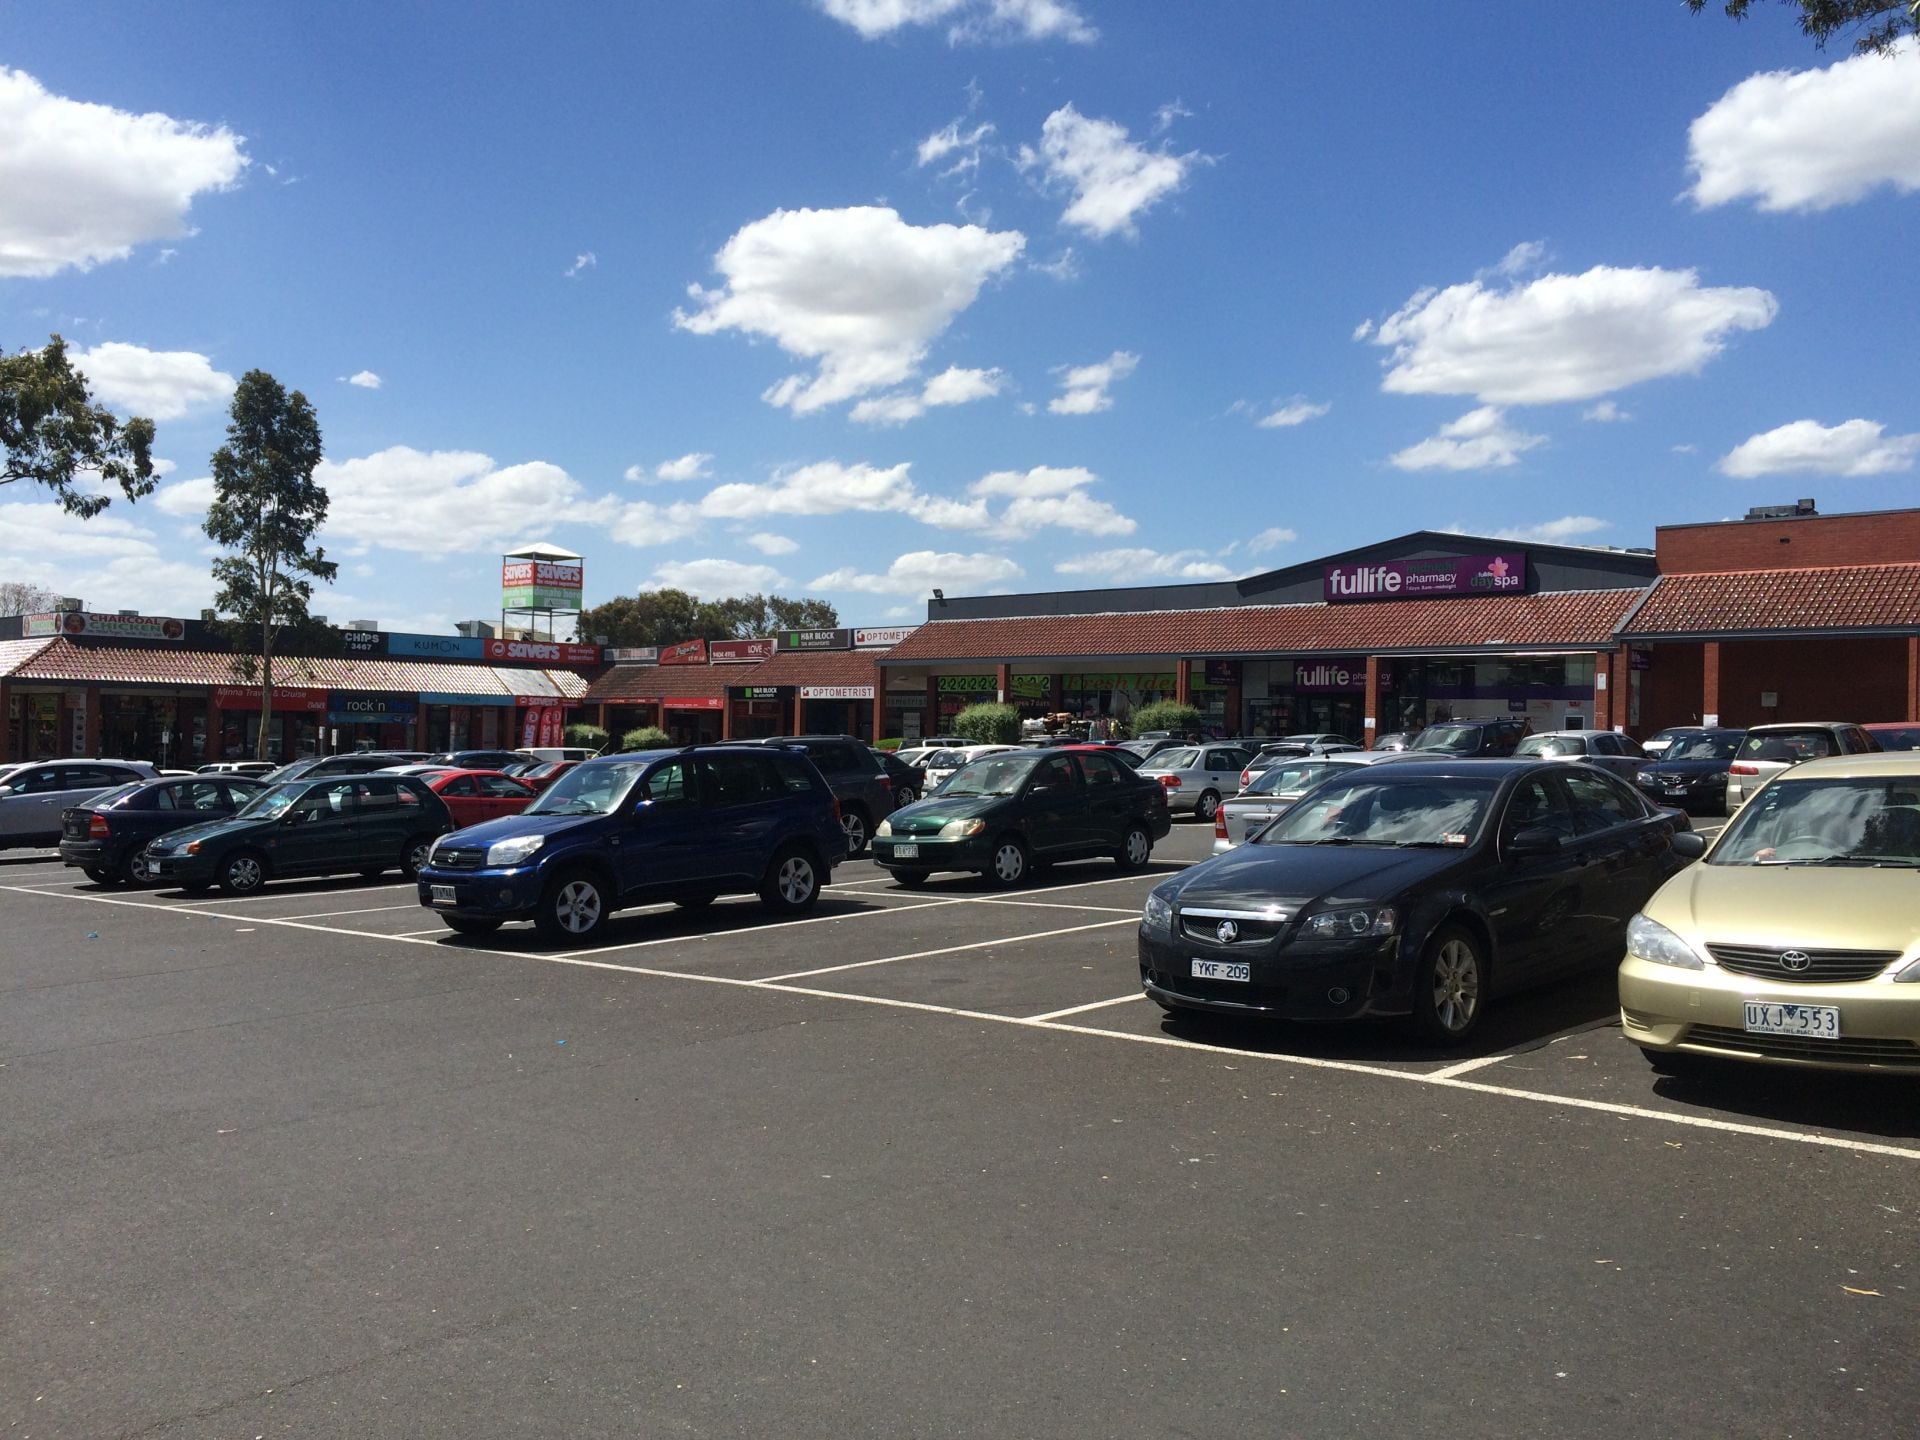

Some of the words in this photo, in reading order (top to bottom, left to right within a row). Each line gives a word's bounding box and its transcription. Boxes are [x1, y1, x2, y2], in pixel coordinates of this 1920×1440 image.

[1330, 567, 1401, 595] fullife
[1405, 572, 1457, 585] pharmacy
[89, 613, 160, 626] CHARCOAL
[344, 632, 379, 643] CHIPS
[814, 631, 835, 639] BLOCK
[414, 640, 460, 652] KUMON
[1066, 673, 1127, 690] Fresh
[1296, 666, 1350, 686] fullife
[812, 687, 873, 697] OPTOMETRIST
[1747, 1006, 1783, 1027] UXJ
[1799, 1009, 1836, 1031] 553
